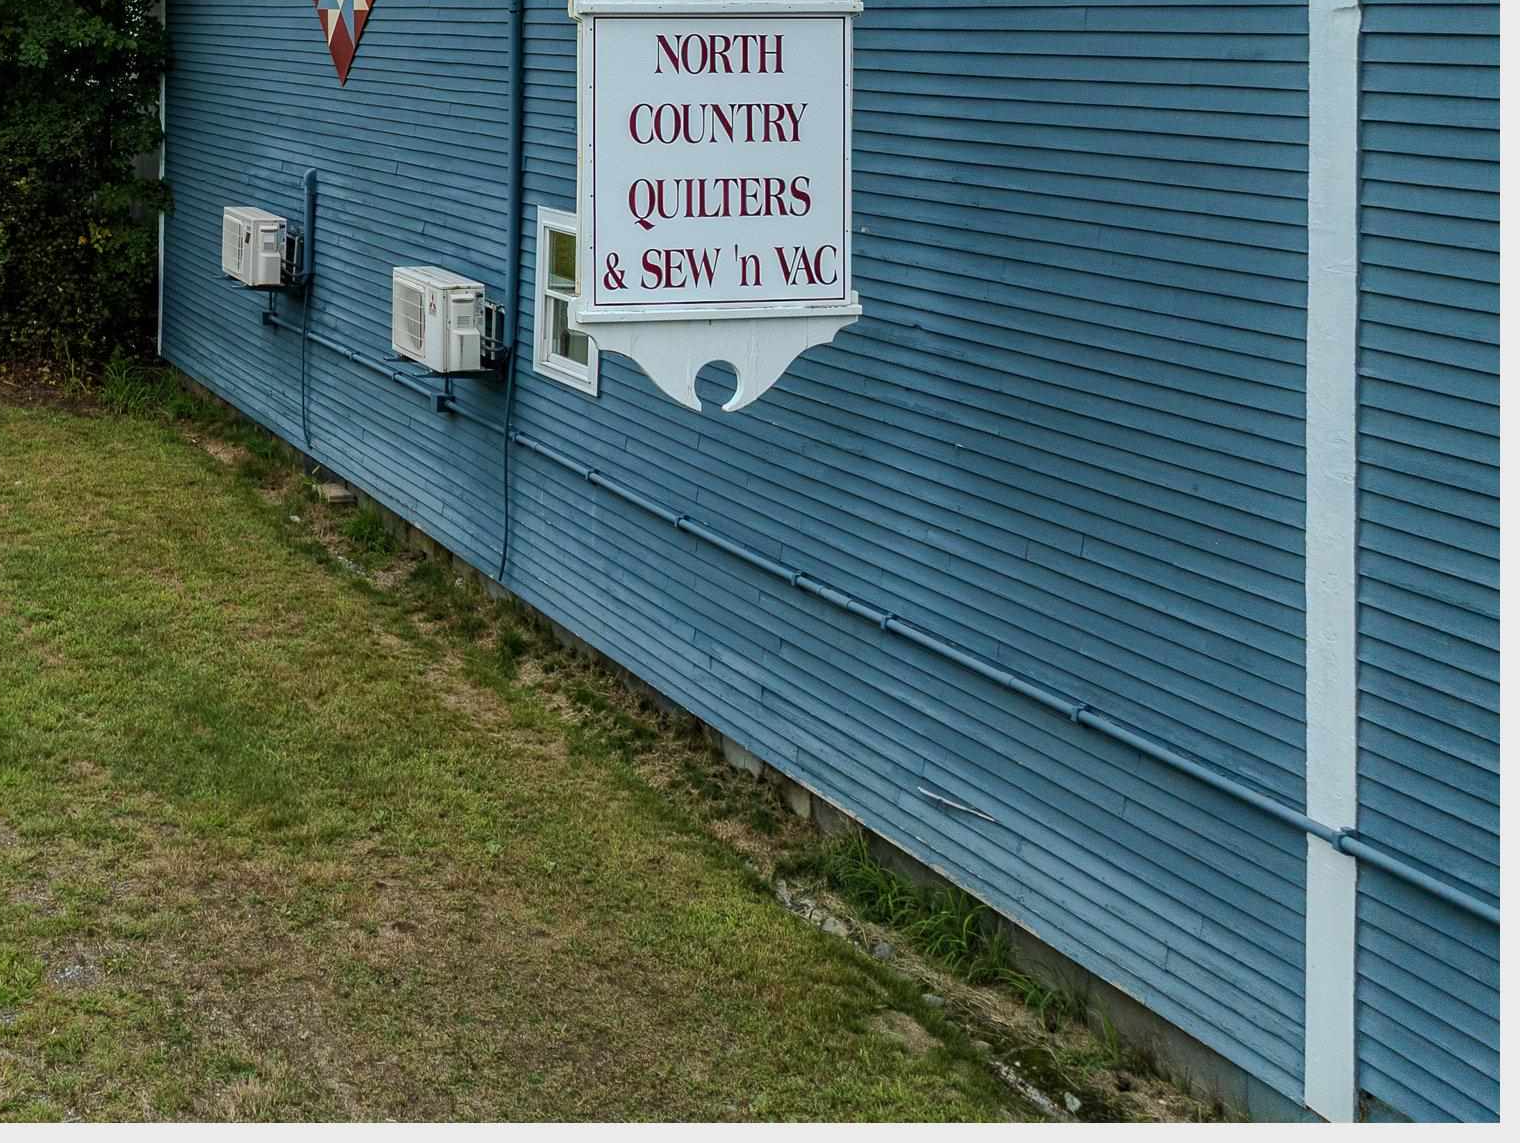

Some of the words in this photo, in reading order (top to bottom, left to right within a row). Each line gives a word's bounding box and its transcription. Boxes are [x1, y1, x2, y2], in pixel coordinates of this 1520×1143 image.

[654, 33, 785, 75] NORTH
[628, 102, 808, 145] COUNTRY
[627, 175, 811, 231] QUILTERS
[603, 252, 629, 291] &
[640, 247, 722, 290] SEW
[733, 243, 762, 287] 'n
[774, 243, 838, 287] VAC
